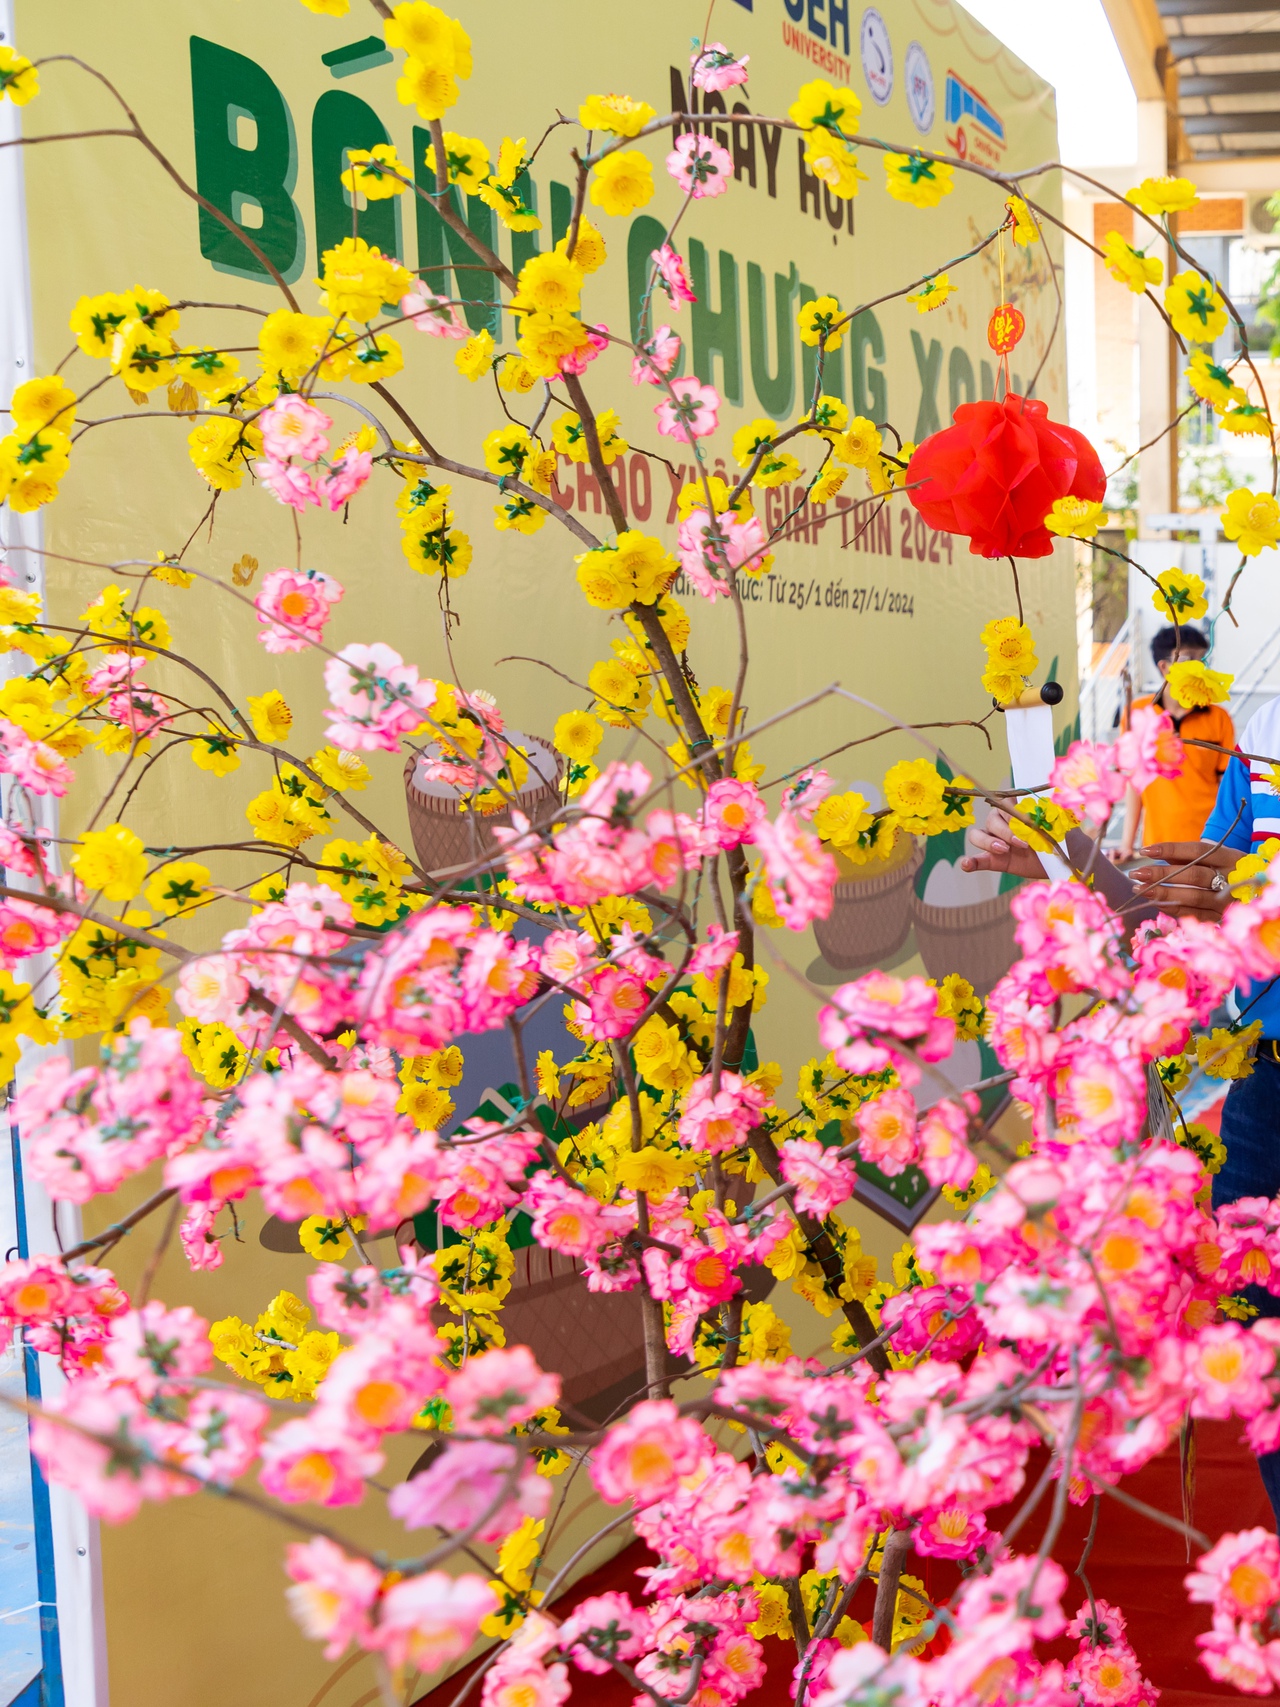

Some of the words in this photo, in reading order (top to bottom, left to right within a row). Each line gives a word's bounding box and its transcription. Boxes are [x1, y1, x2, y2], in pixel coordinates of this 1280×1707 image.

[782, 20, 851, 85] UNIVERSITY
[627, 214, 888, 441] CHƯNG
[900, 508, 953, 565] 2024
[788, 579, 822, 610] 25/1
[825, 578, 850, 609] đến
[852, 586, 915, 618] 27/1/2024
